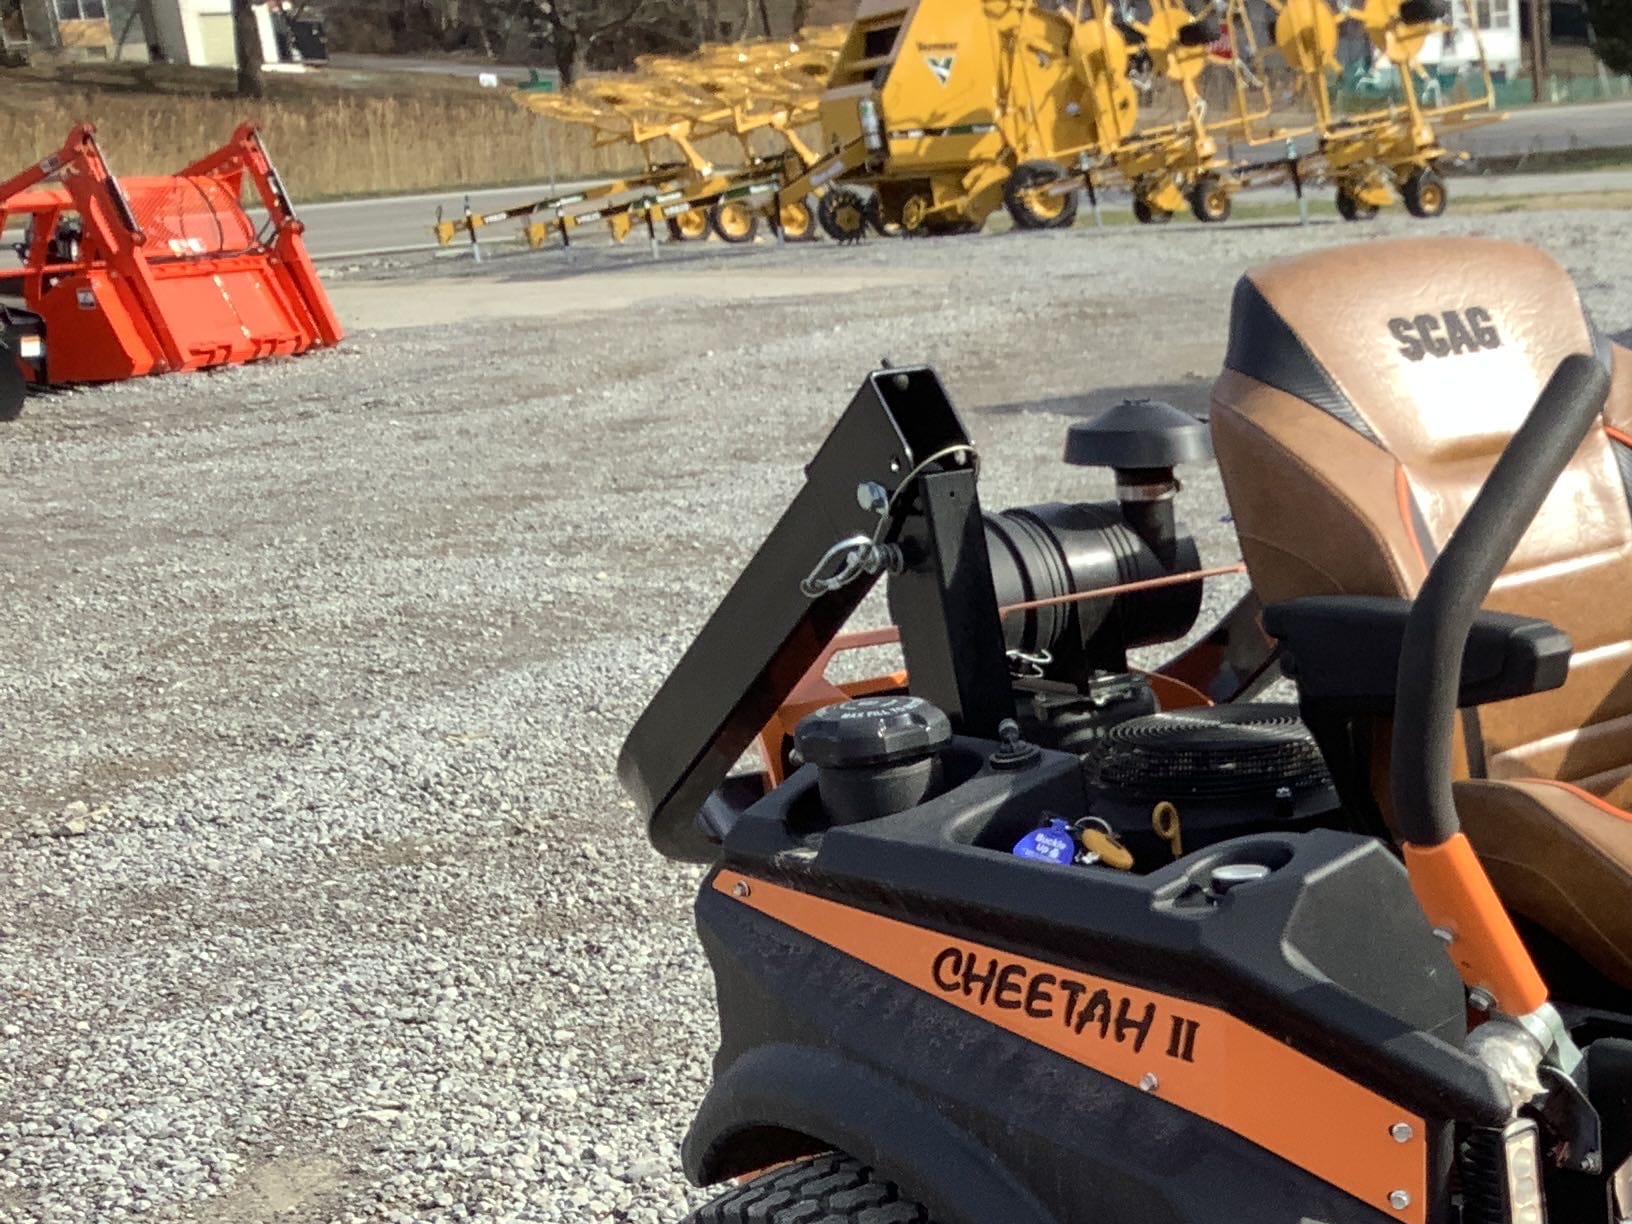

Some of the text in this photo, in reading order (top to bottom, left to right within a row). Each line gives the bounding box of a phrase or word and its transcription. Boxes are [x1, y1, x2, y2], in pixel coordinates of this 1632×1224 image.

[1388, 306, 1500, 361] SCAG
[931, 947, 1200, 1062] CHEETAH II
